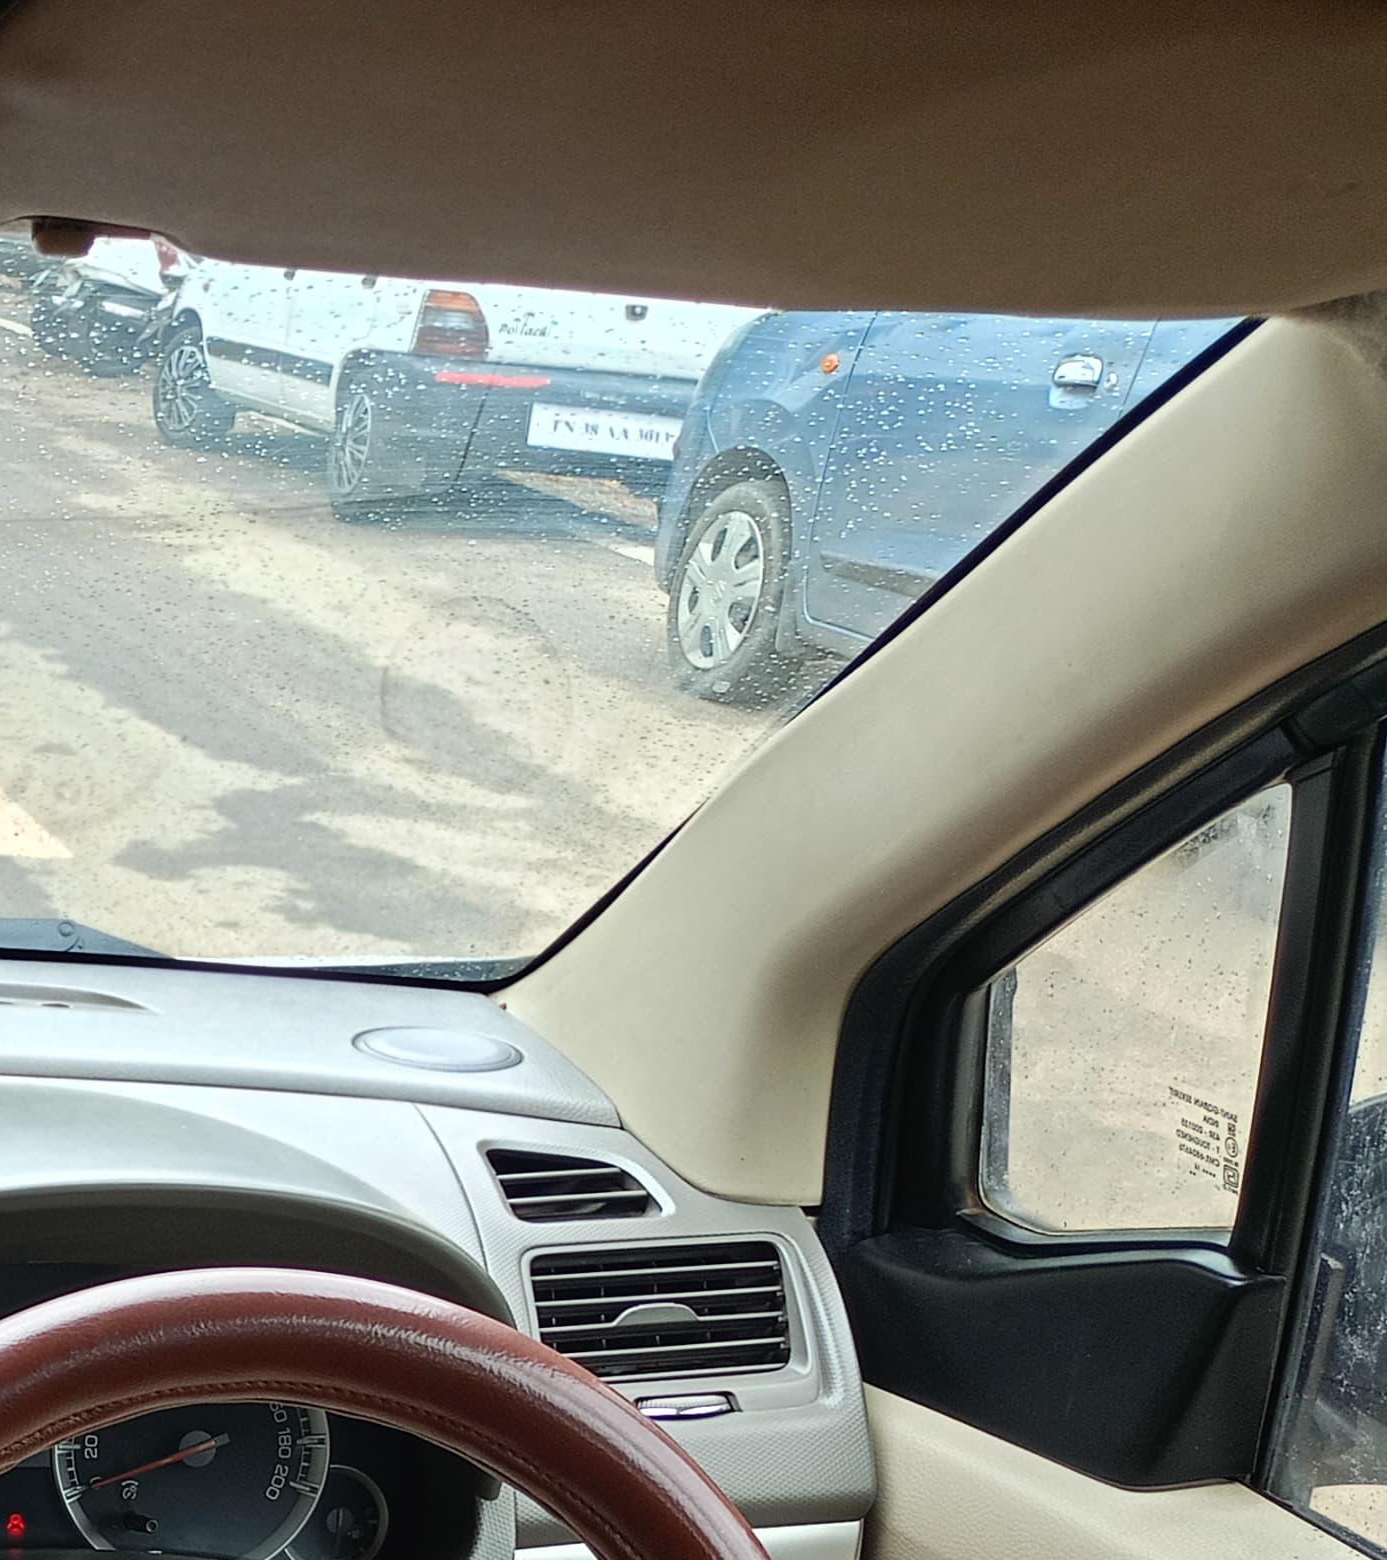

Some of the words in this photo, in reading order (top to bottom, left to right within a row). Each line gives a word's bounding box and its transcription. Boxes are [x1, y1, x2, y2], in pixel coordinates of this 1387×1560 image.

[84, 1434, 99, 1459] 20
[278, 1427, 292, 1459] 180
[266, 1463, 289, 1500] 200
